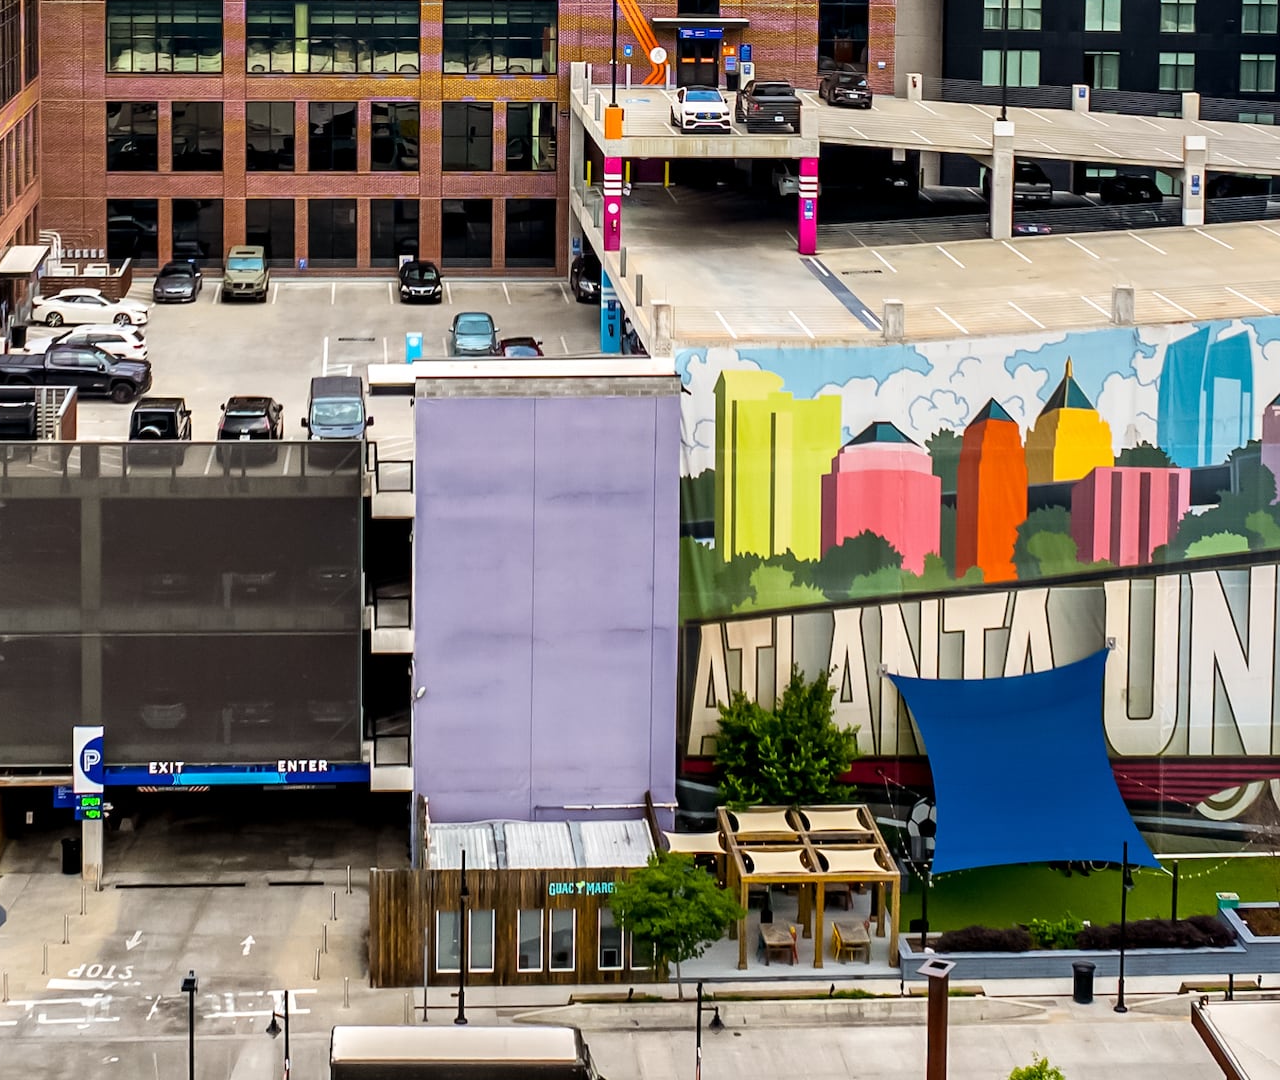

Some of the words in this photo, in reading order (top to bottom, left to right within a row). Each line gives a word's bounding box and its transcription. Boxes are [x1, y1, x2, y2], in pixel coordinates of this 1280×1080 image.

[83, 749, 101, 772] P
[148, 761, 185, 774] EXIT
[277, 760, 328, 773] ENTER
[548, 881, 575, 897] GUAC
[67, 963, 135, 980] STOP
